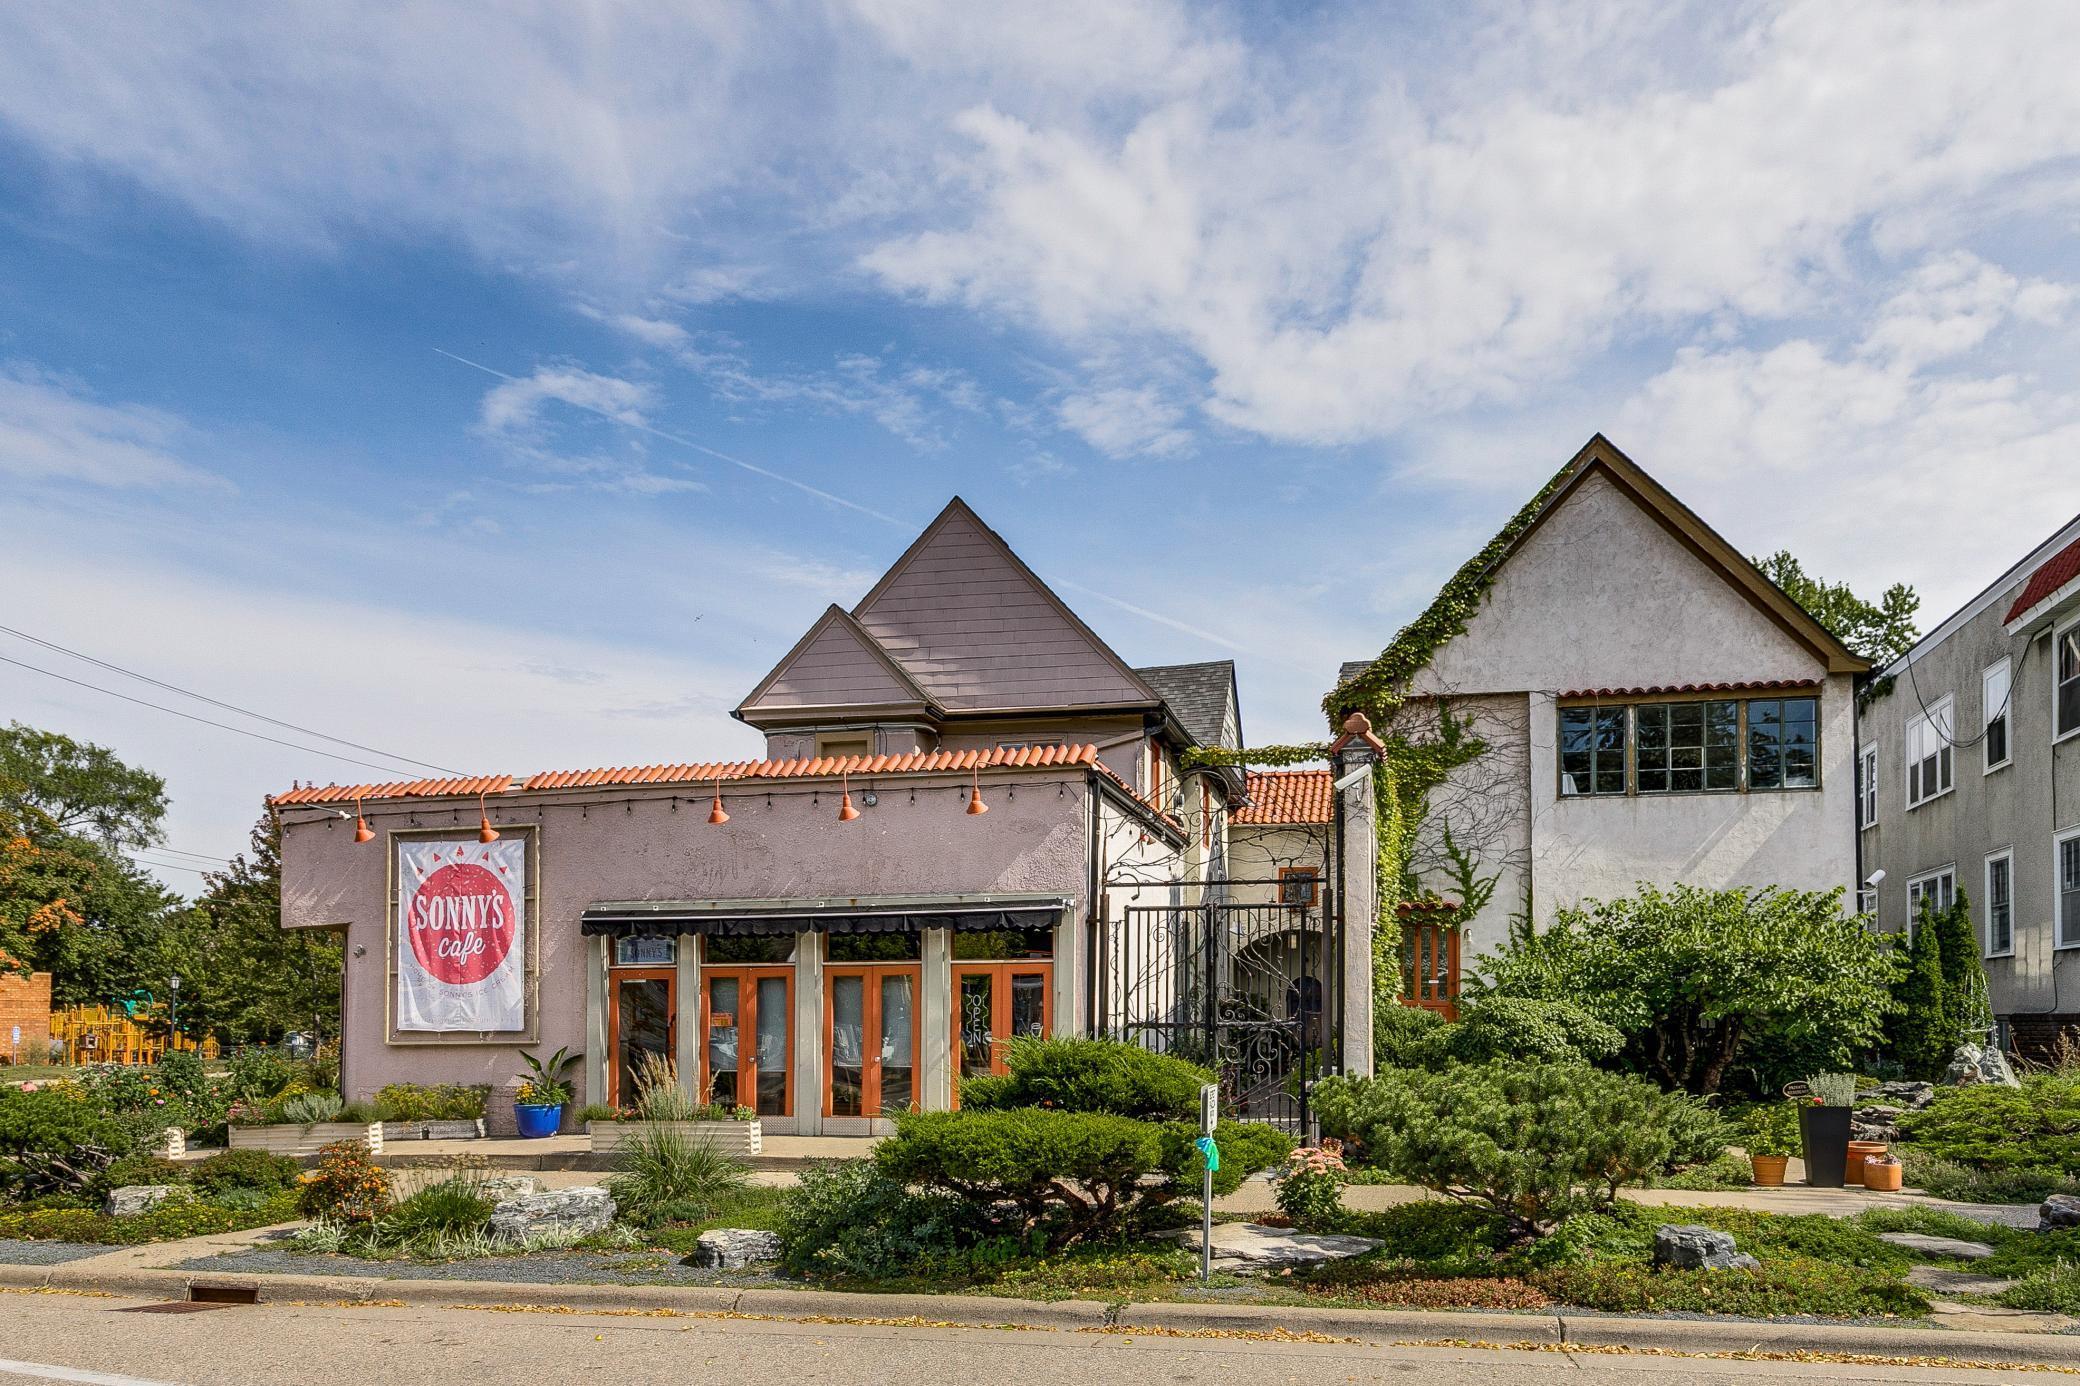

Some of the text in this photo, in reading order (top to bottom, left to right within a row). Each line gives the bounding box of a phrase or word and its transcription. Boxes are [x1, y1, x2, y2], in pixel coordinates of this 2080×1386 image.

[415, 889, 504, 931] SONNY'S
[438, 932, 486, 966] cafe
[973, 995, 982, 1043] OPEN
